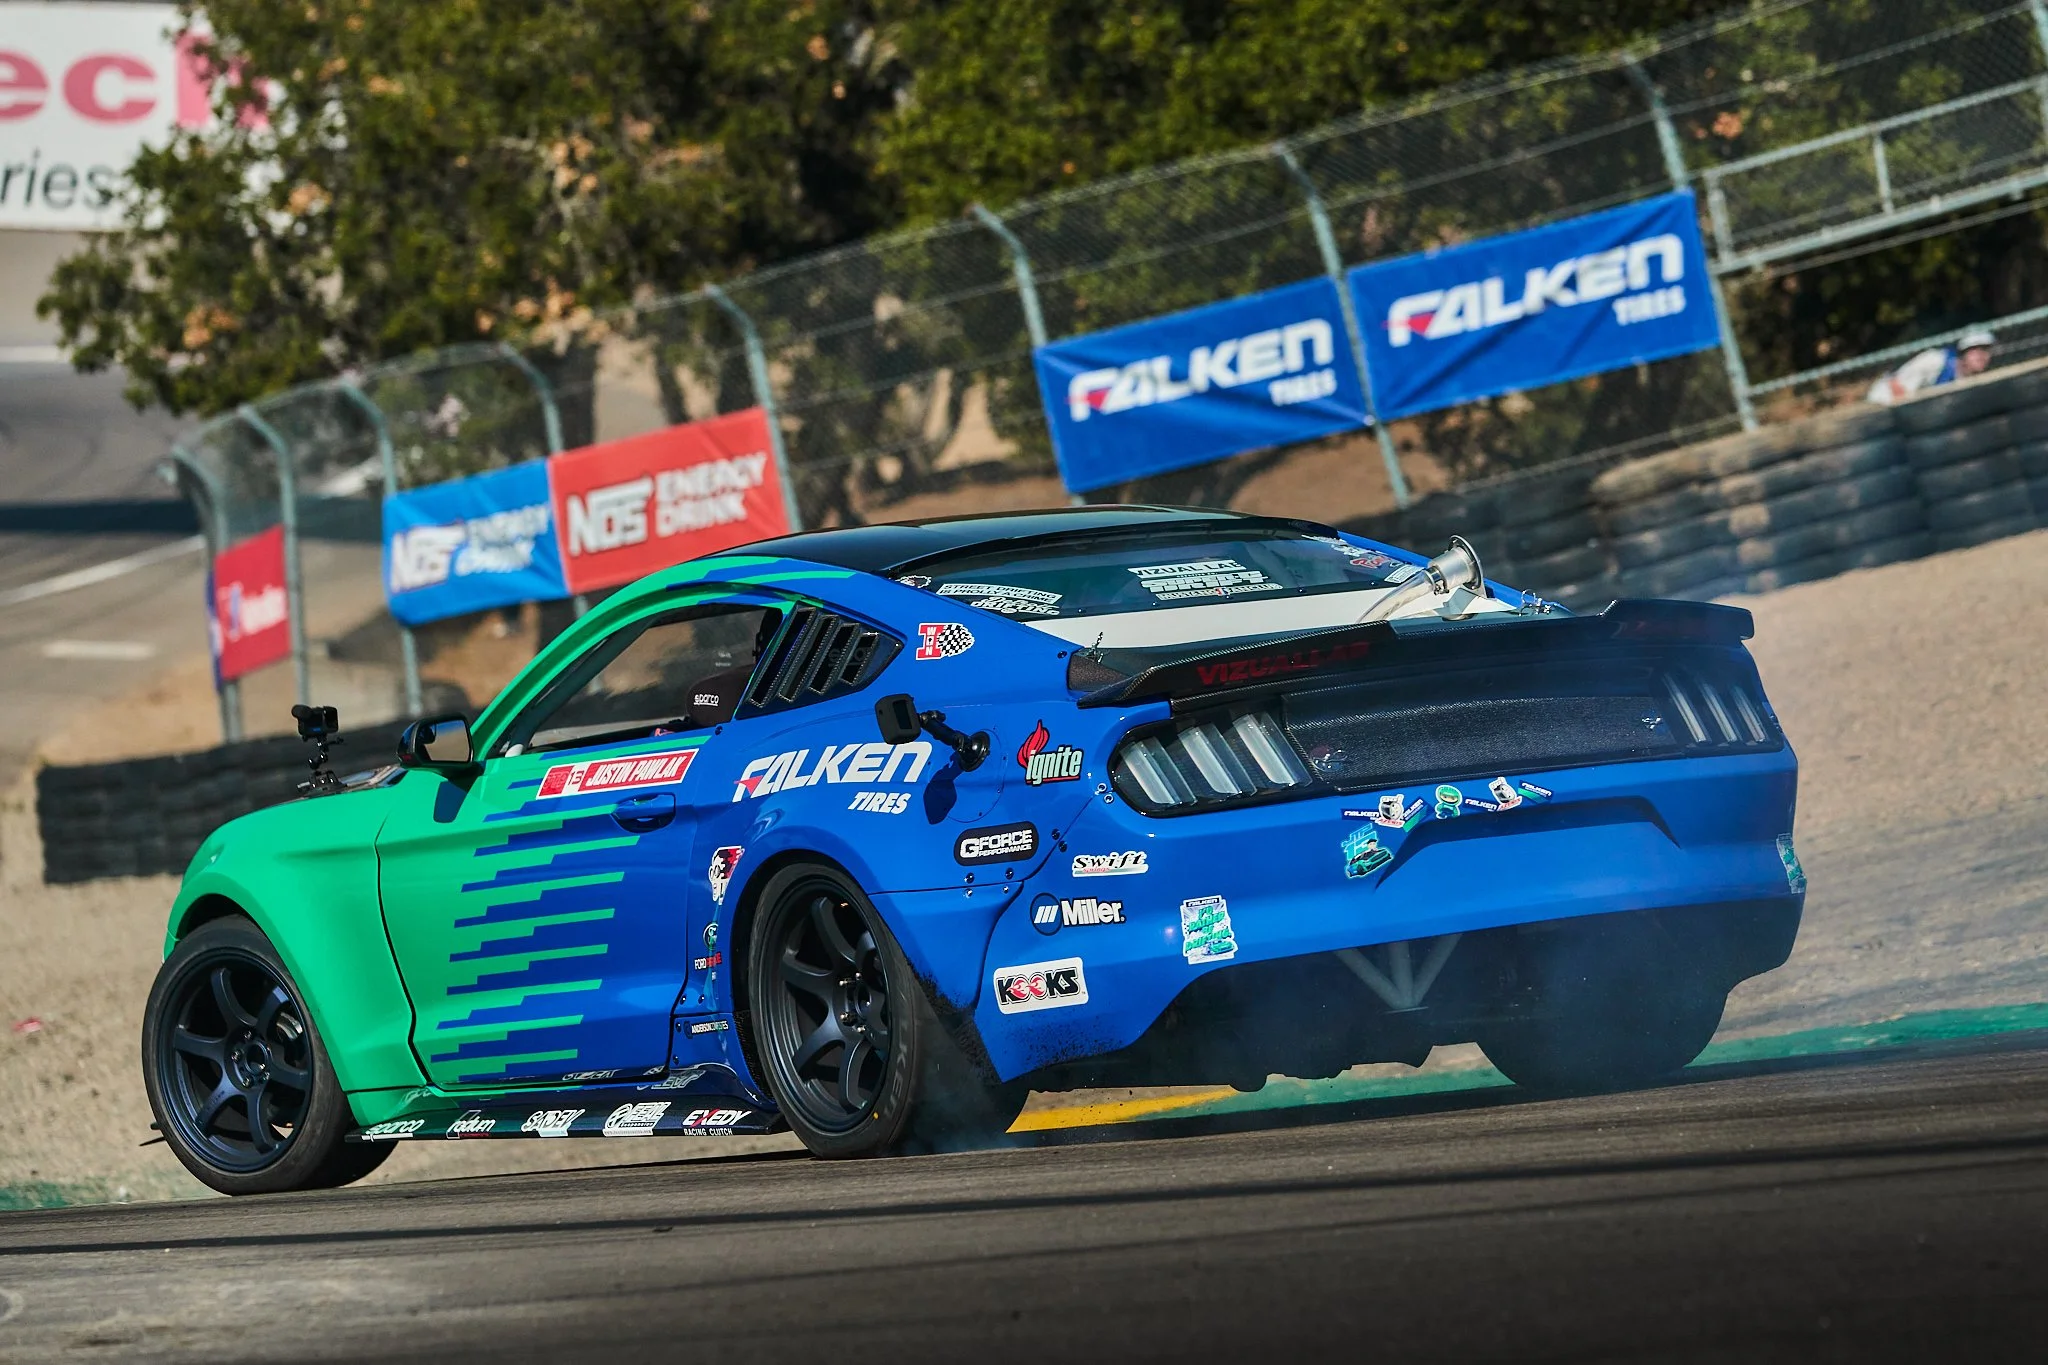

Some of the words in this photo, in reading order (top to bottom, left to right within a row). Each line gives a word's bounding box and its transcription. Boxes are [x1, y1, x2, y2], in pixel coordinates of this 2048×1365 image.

[1386, 232, 1684, 348] FALKEN
[1614, 284, 1686, 326] TIRES
[1068, 318, 1334, 422] FALKEN
[1268, 368, 1336, 406] TIRES
[655, 451, 768, 502] ENERGY
[566, 474, 654, 558] NOS
[655, 490, 747, 538] DRINK
[390, 521, 466, 595] NOS
[996, 586, 1057, 599] DRIFTING
[693, 693, 720, 706] sparco
[585, 761, 637, 787] JUSTIN
[629, 755, 687, 782] PAWLAK
[732, 741, 933, 802] FALKEN
[1026, 747, 1083, 785] ignite
[848, 792, 911, 815] TIRES
[1465, 798, 1498, 811] FALKEN
[1521, 782, 1553, 797] FALKEN
[1344, 809, 1380, 818] FALKEN
[978, 844, 1032, 857] PERFORMANCE
[1074, 853, 1143, 869] Swift
[1188, 898, 1218, 908] FALKEN
[996, 966, 1079, 1005] KOOKS
[682, 1108, 752, 1127] EXEDY
[684, 1127, 708, 1136] RACING
[709, 1127, 733, 1136] CLUTCH
